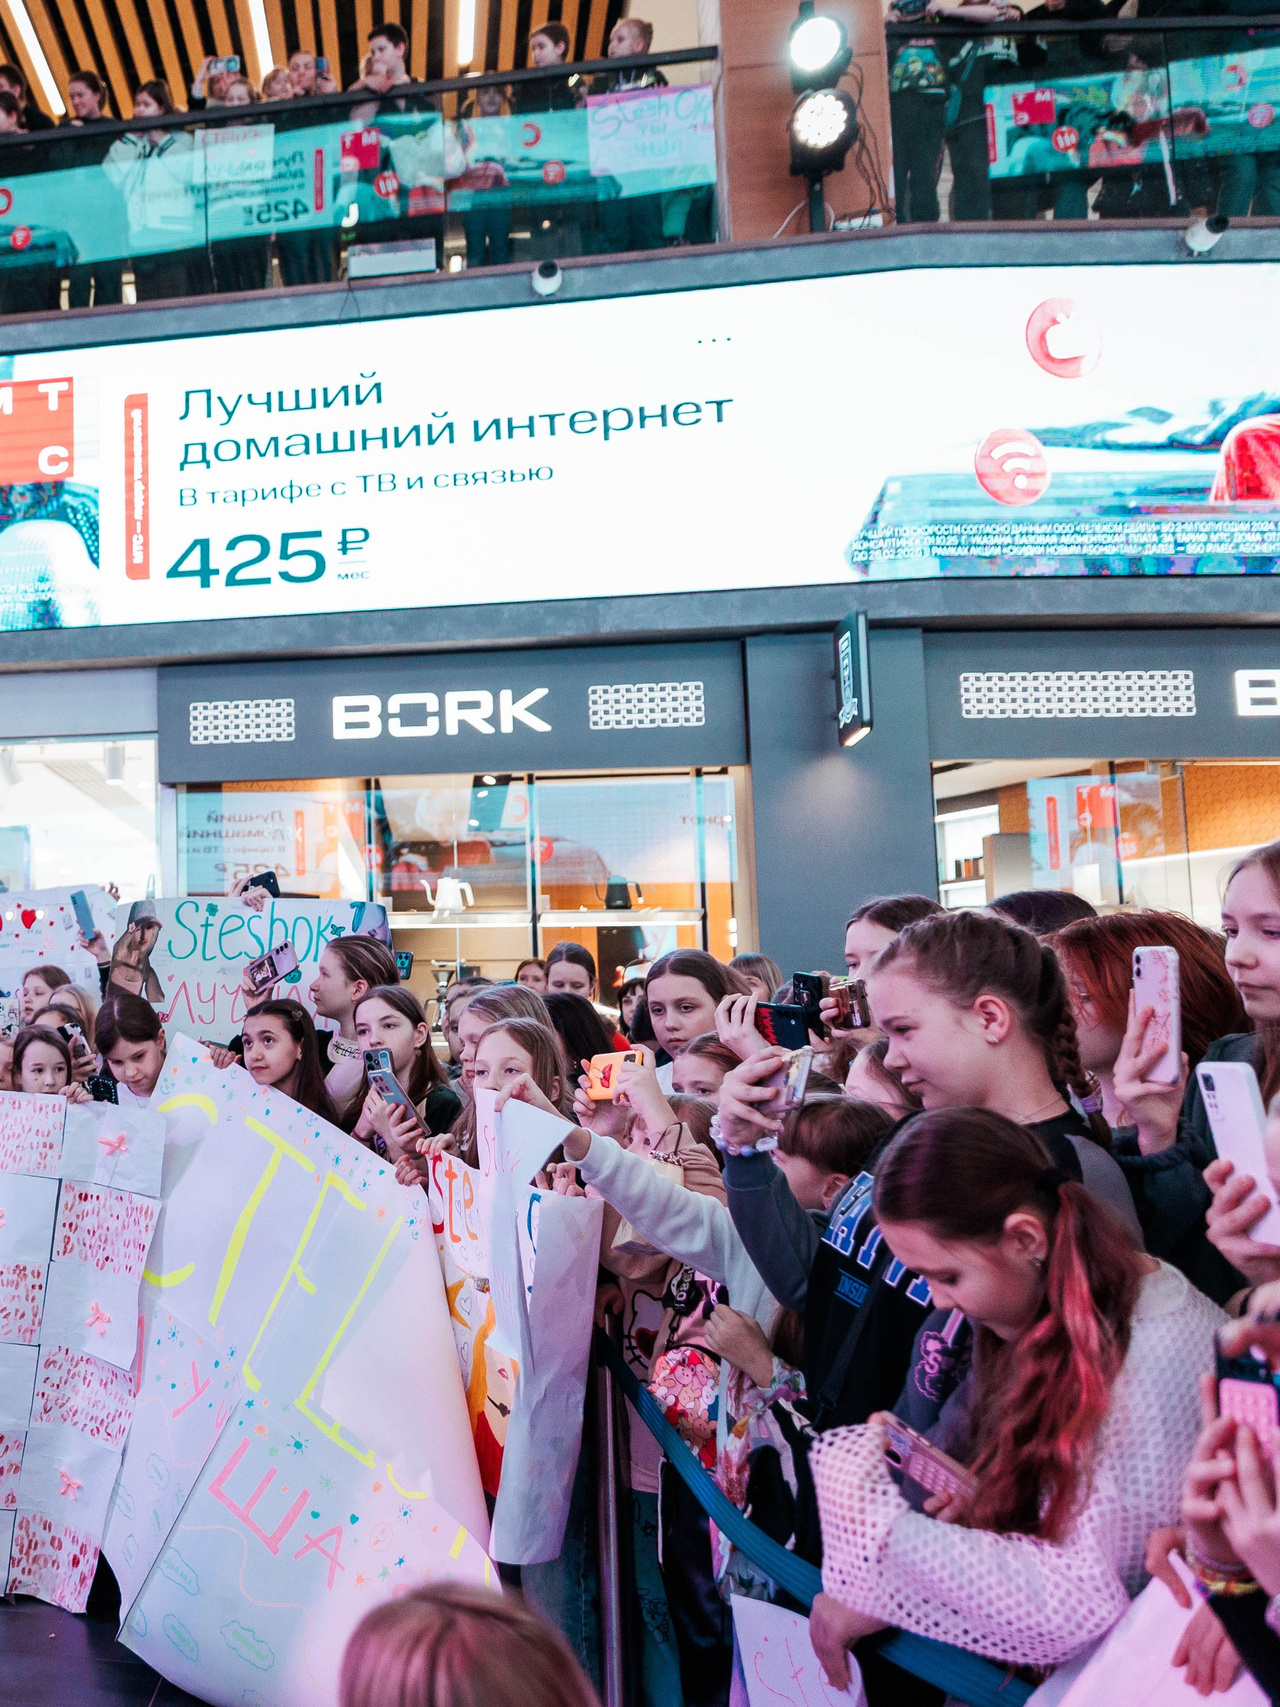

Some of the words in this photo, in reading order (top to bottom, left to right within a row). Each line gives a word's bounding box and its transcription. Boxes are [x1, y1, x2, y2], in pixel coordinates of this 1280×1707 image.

[179, 371, 384, 426] Лучший
[179, 413, 457, 471] домашний
[473, 394, 735, 450] интернет
[180, 486, 198, 506] В
[206, 476, 322, 510] тарифе
[330, 482, 347, 497] с
[355, 472, 399, 494] ТВ
[406, 475, 426, 491] и
[433, 464, 555, 490] связью
[166, 529, 328, 589] 425
[336, 568, 371, 582] мес
[330, 686, 554, 741] BORK
